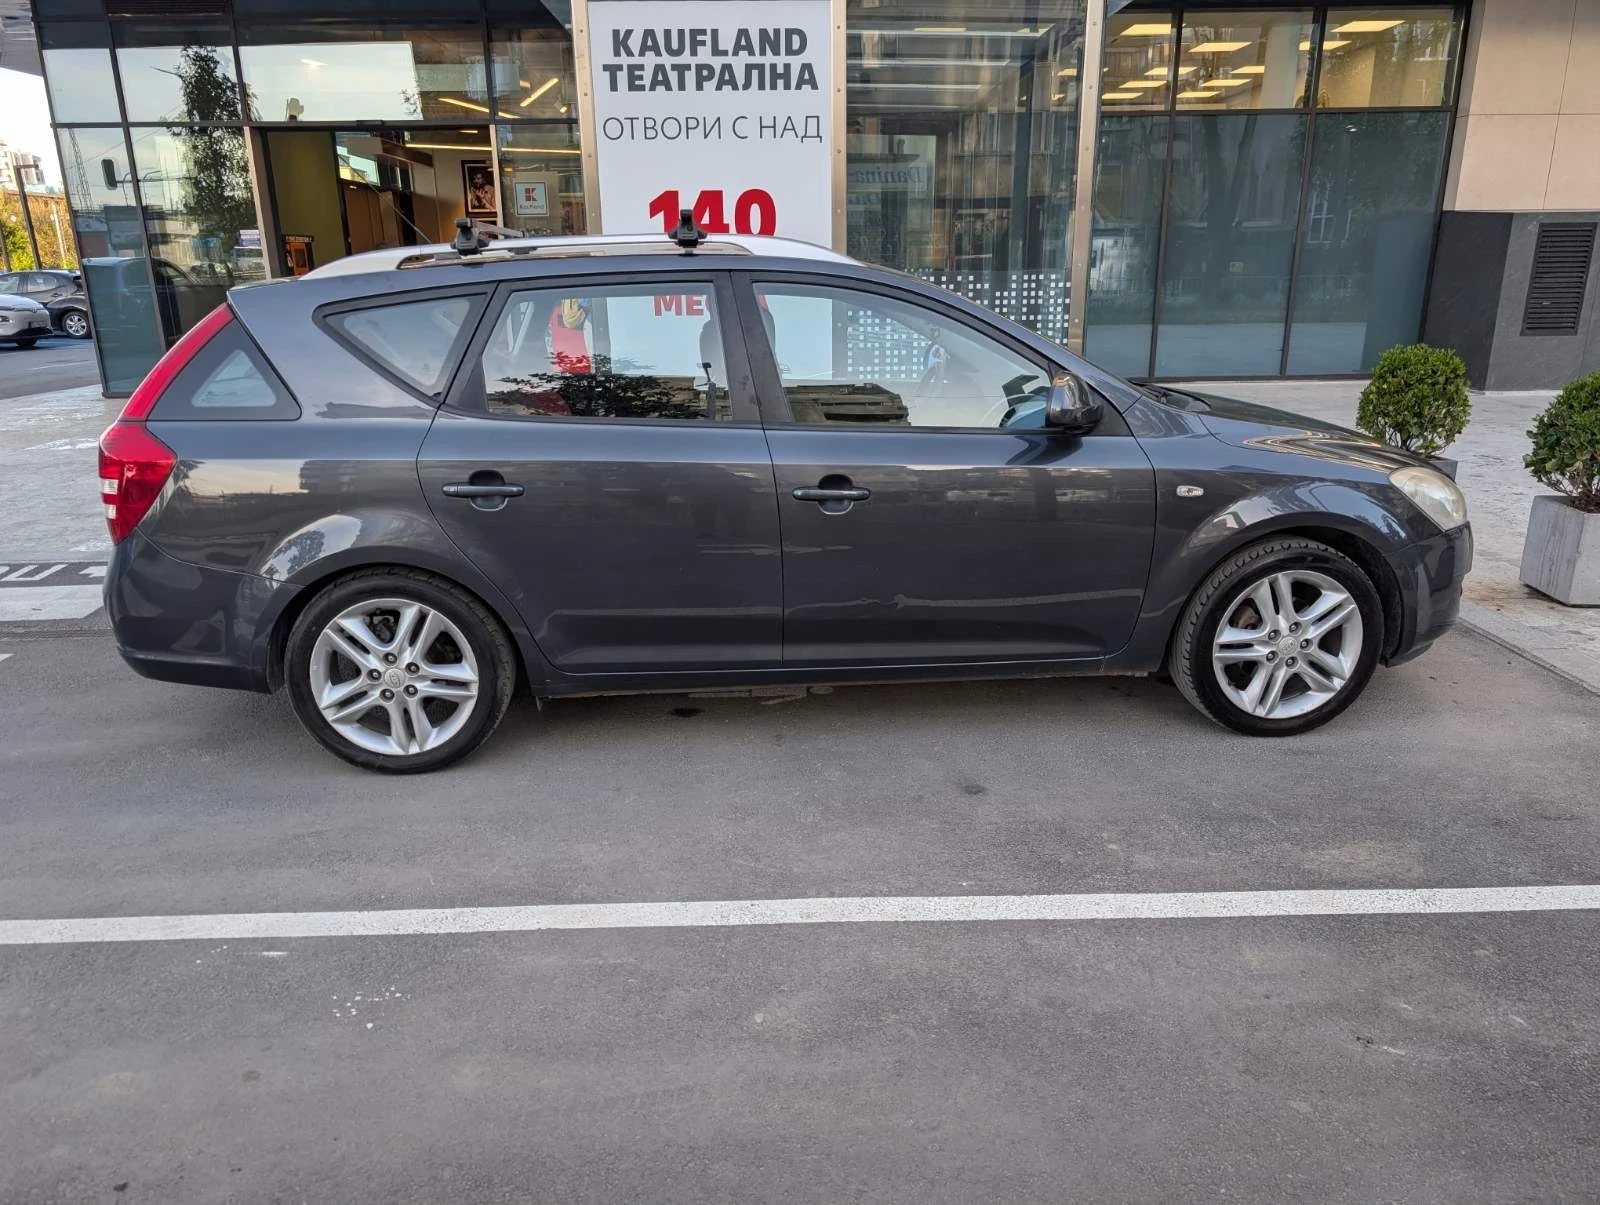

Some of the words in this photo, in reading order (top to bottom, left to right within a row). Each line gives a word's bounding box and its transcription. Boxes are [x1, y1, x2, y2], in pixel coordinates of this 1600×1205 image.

[612, 28, 808, 57] KAUFLAND
[602, 63, 819, 92] ТЕАТРАЛНА
[603, 116, 721, 140] ОТВОРИ
[732, 115, 749, 140] С
[759, 115, 823, 144] НАД
[649, 188, 777, 237] 140
